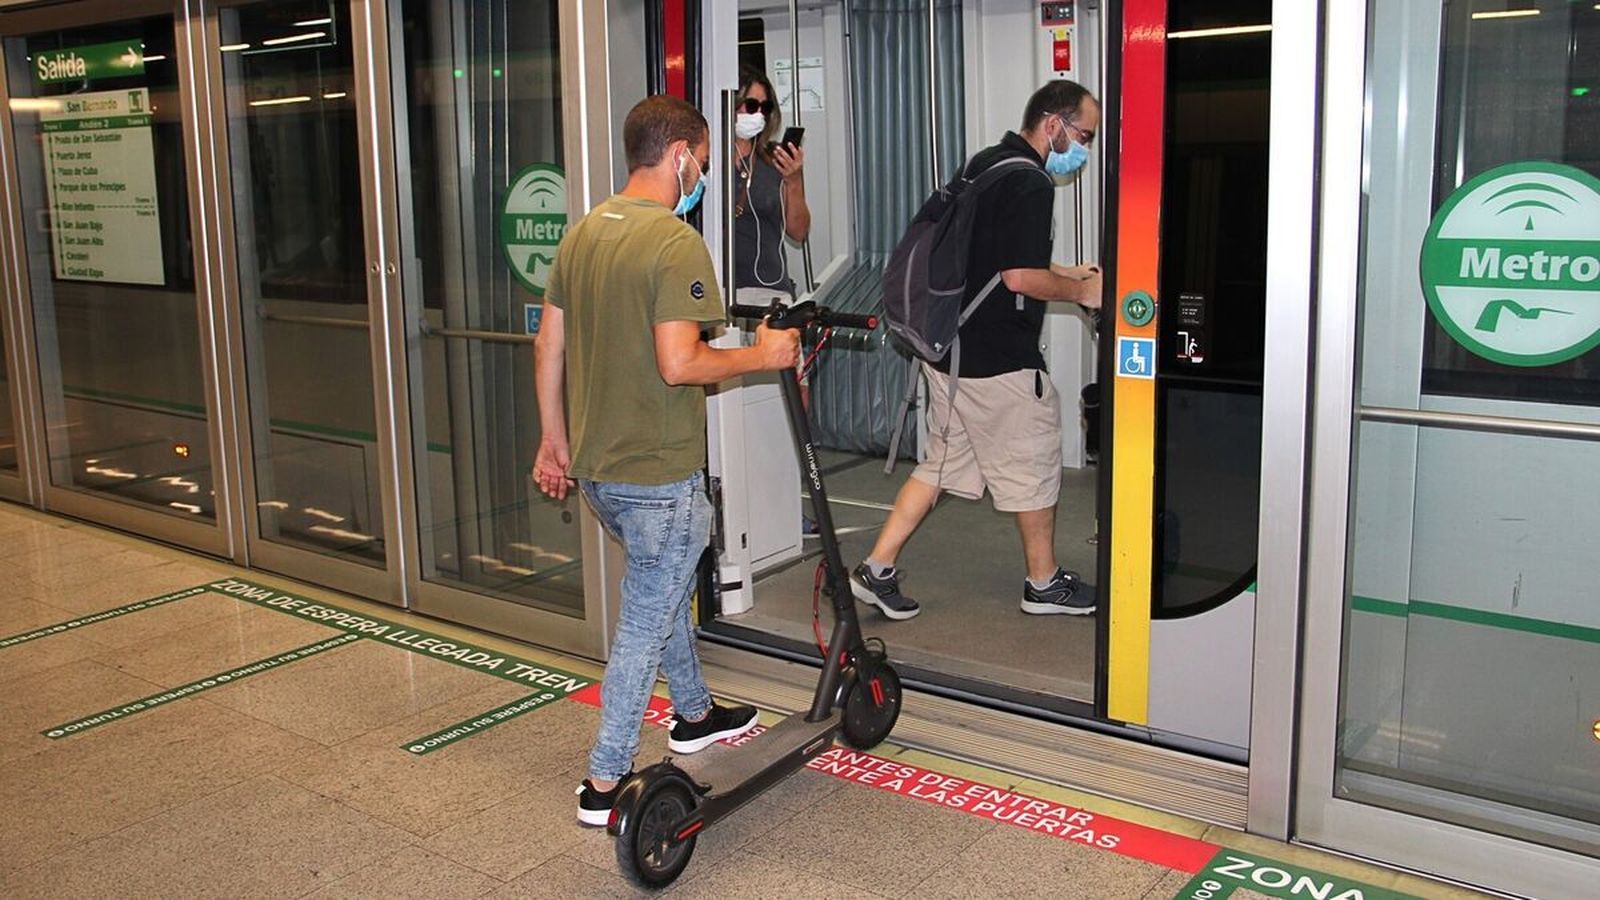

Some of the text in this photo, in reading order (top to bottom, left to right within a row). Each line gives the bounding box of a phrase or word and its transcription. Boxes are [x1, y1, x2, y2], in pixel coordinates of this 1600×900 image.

[38, 52, 86, 80] Salida
[67, 101, 80, 112] San
[1460, 248, 1600, 282] Metro
[214, 579, 590, 693] ZONA DE ESPERA LLEGADA TREN
[230, 637, 346, 678] ESPERE SU TURNO
[64, 684, 202, 732] ESPERE SU TURNO
[424, 698, 544, 747] ESPERE SU TURNO
[820, 748, 1095, 827] ANTES DE ENTRAR
[886, 777, 904, 792] A
[907, 784, 970, 808] LAS
[970, 802, 1122, 849] PUERTAS
